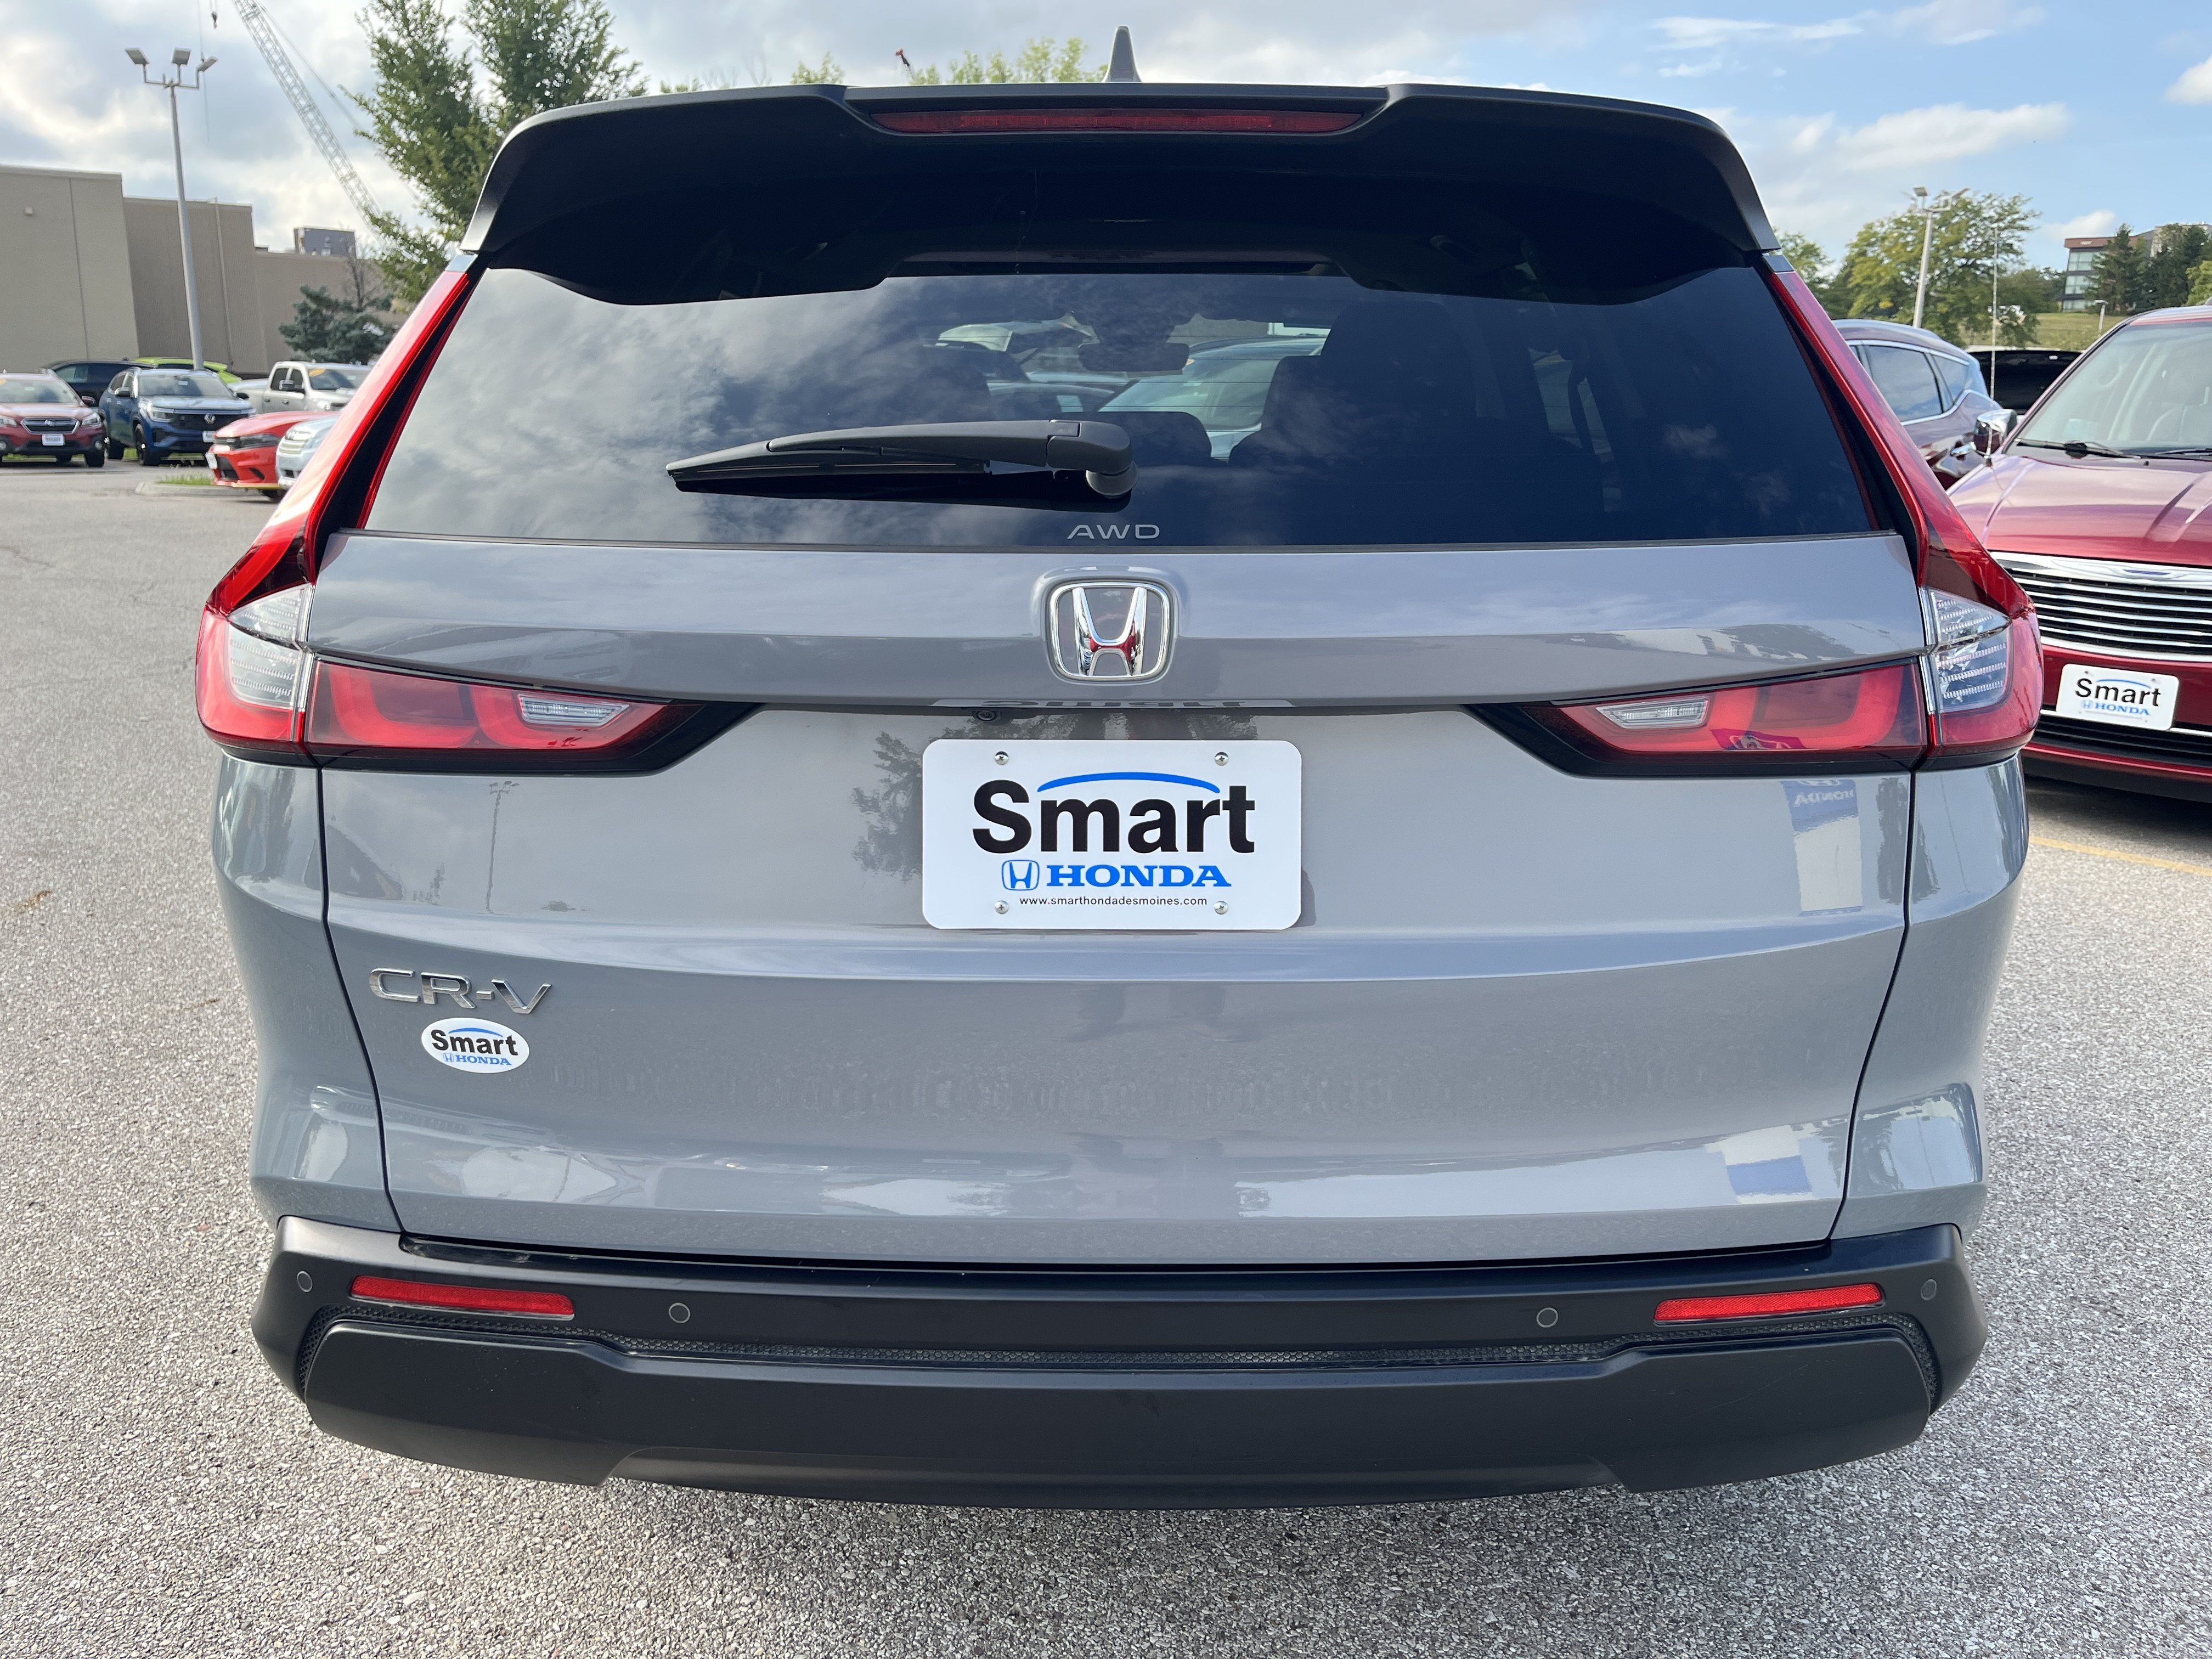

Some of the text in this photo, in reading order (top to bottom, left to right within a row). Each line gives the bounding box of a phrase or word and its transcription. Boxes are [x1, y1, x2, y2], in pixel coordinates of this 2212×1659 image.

[1066, 524, 1160, 539] AWD
[2075, 678, 2162, 707] Smart
[2095, 702, 2151, 716] HONDA
[972, 780, 1255, 854] Smart
[1046, 864, 1232, 887] HONDA
[1019, 896, 1207, 906] www.smarthondadesmoines.com
[369, 968, 552, 1014] CR-V
[431, 1029, 518, 1056] Smart
[455, 1054, 512, 1066] HONDA
